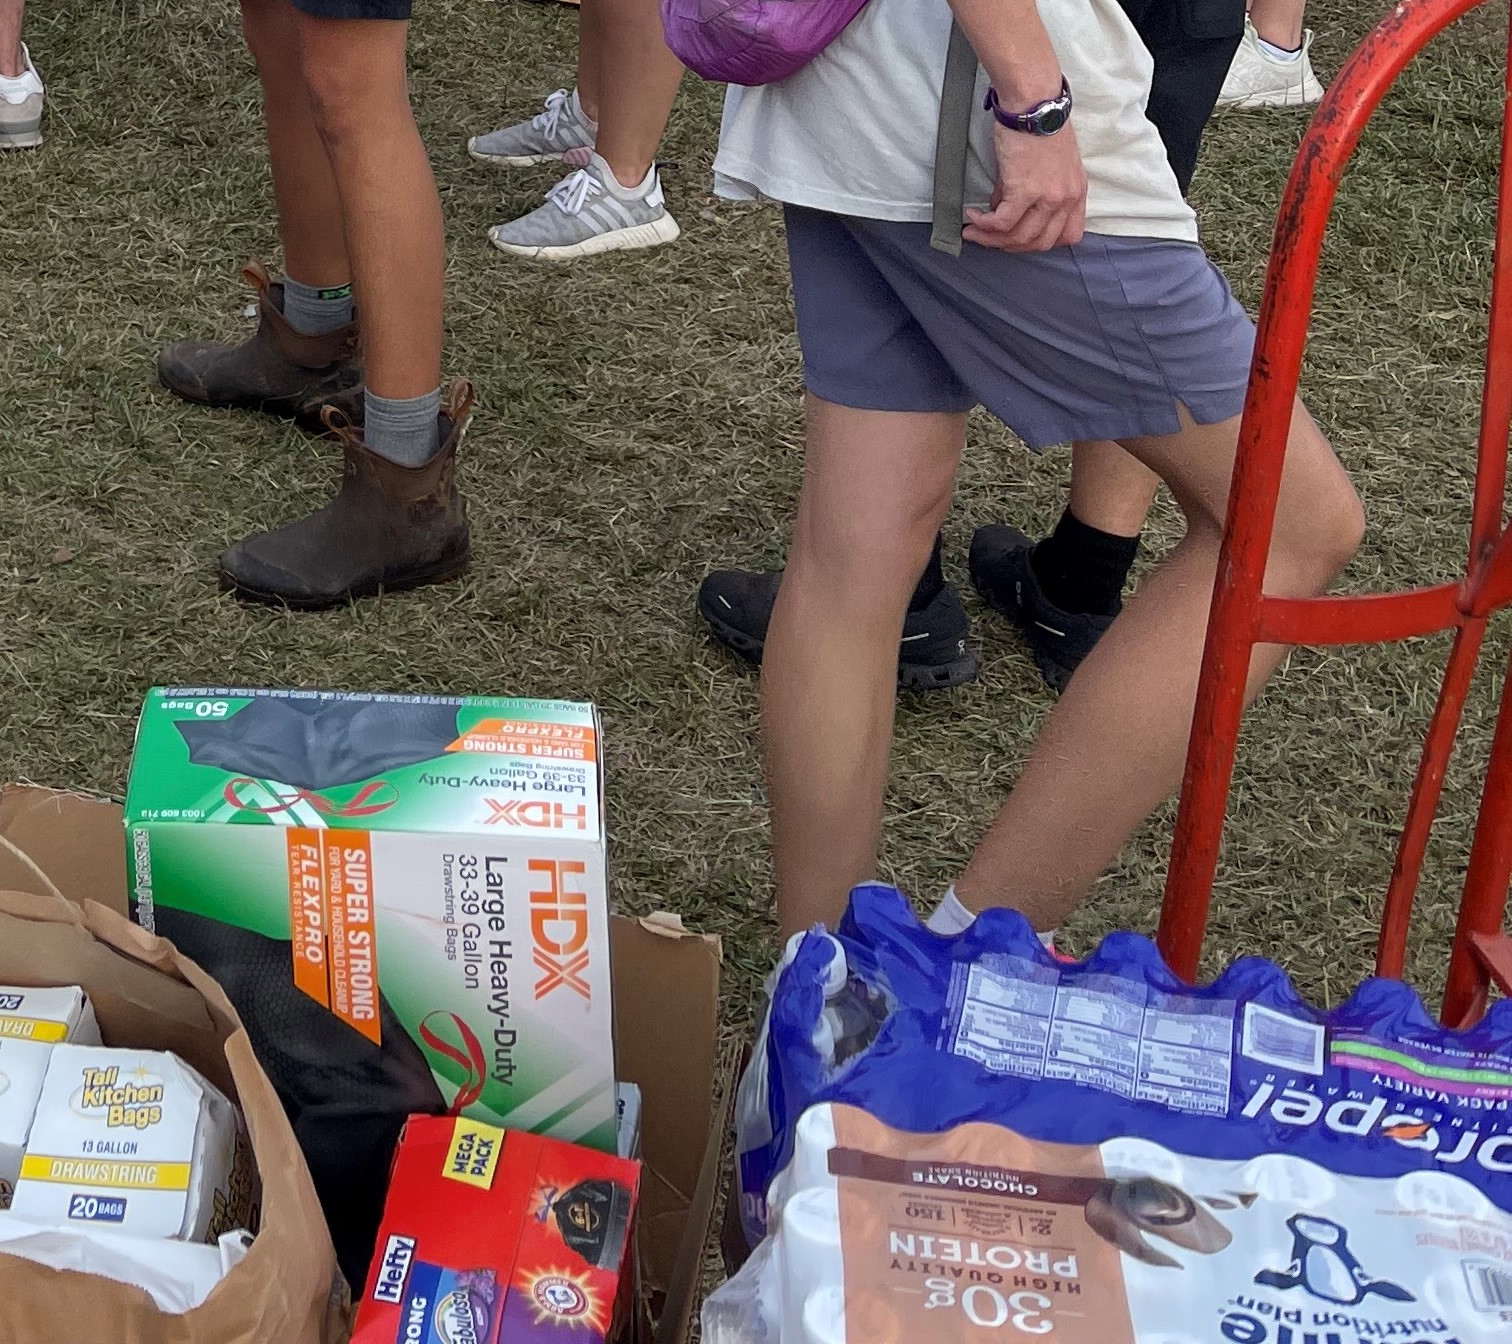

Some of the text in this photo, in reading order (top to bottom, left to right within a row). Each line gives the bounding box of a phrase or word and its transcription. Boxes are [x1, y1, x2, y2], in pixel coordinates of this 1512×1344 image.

[195, 701, 229, 717] 50
[502, 725, 585, 740] FLEXPRO
[463, 739, 585, 759] SUPER STRONG
[489, 767, 586, 784] 33-39 Gallon
[509, 761, 534, 771] Bags
[418, 772, 586, 797] Large Heavy-Duty
[482, 798, 587, 830] HDX
[290, 844, 305, 958] TEAR RESISTANCE
[300, 843, 323, 963] FLEXPRO
[442, 853, 459, 961] Drawstring Bags
[343, 847, 375, 1020] SUPER STRONG
[458, 853, 483, 990] 33-39 Gallon
[527, 858, 592, 1001] HDX
[481, 855, 520, 1088] Large Heavy-Duty
[82, 1065, 120, 1088] Tall
[1265, 1074, 1364, 1100] WATER
[1371, 1073, 1451, 1104] VARIETY
[81, 1082, 165, 1109] Kitchen
[1455, 1094, 1509, 1111] PACK
[106, 1105, 163, 1130] Bags
[82, 1140, 139, 1155] 13 GALLON
[452, 1132, 477, 1175] MEGA
[470, 1138, 495, 1178] PACK
[50, 1161, 158, 1185] DRAWSTRING
[911, 1171, 1039, 1197] CHOCOLATE
[71, 1196, 124, 1219] 20 BAGS
[905, 1206, 947, 1220] 150
[889, 1230, 1079, 1278] PROTEIN
[377, 1238, 413, 1299] Hefty
[890, 1257, 1082, 1295] HIGH QUALITY
[924, 1277, 1055, 1334] 30g
[1235, 1294, 1302, 1325] plan
[1312, 1312, 1449, 1338] nutrition
